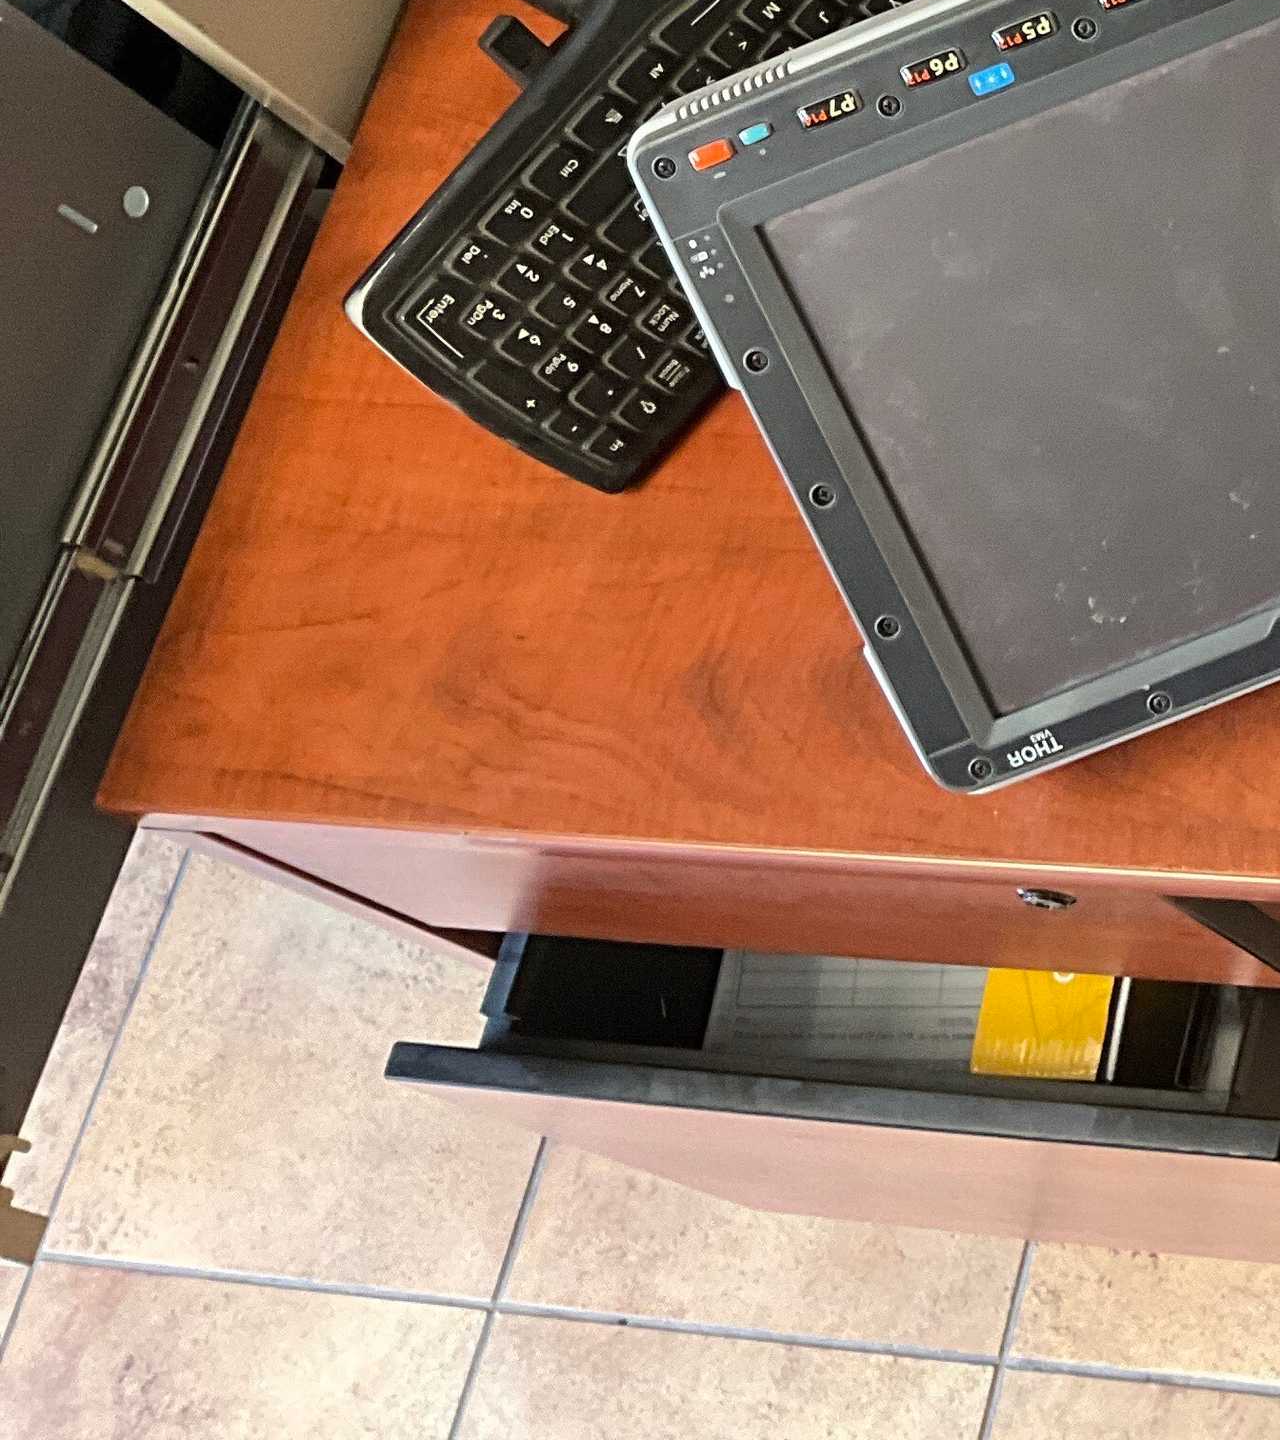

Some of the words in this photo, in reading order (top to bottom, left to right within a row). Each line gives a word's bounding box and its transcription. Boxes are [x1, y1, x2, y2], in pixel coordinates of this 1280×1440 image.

[1021, 13, 1051, 39] P5
[929, 53, 960, 76] P6
[829, 93, 856, 116] P7
[560, 159, 579, 178] Ctrl
[538, 225, 560, 246] End
[609, 278, 633, 302] Home
[425, 293, 455, 324] Enter
[467, 299, 494, 326] PgDn
[648, 304, 671, 326] Lock
[657, 311, 680, 333] Num
[545, 353, 567, 375] PgUp
[1030, 729, 1053, 743] VM3
[1006, 736, 1064, 768] THOR
